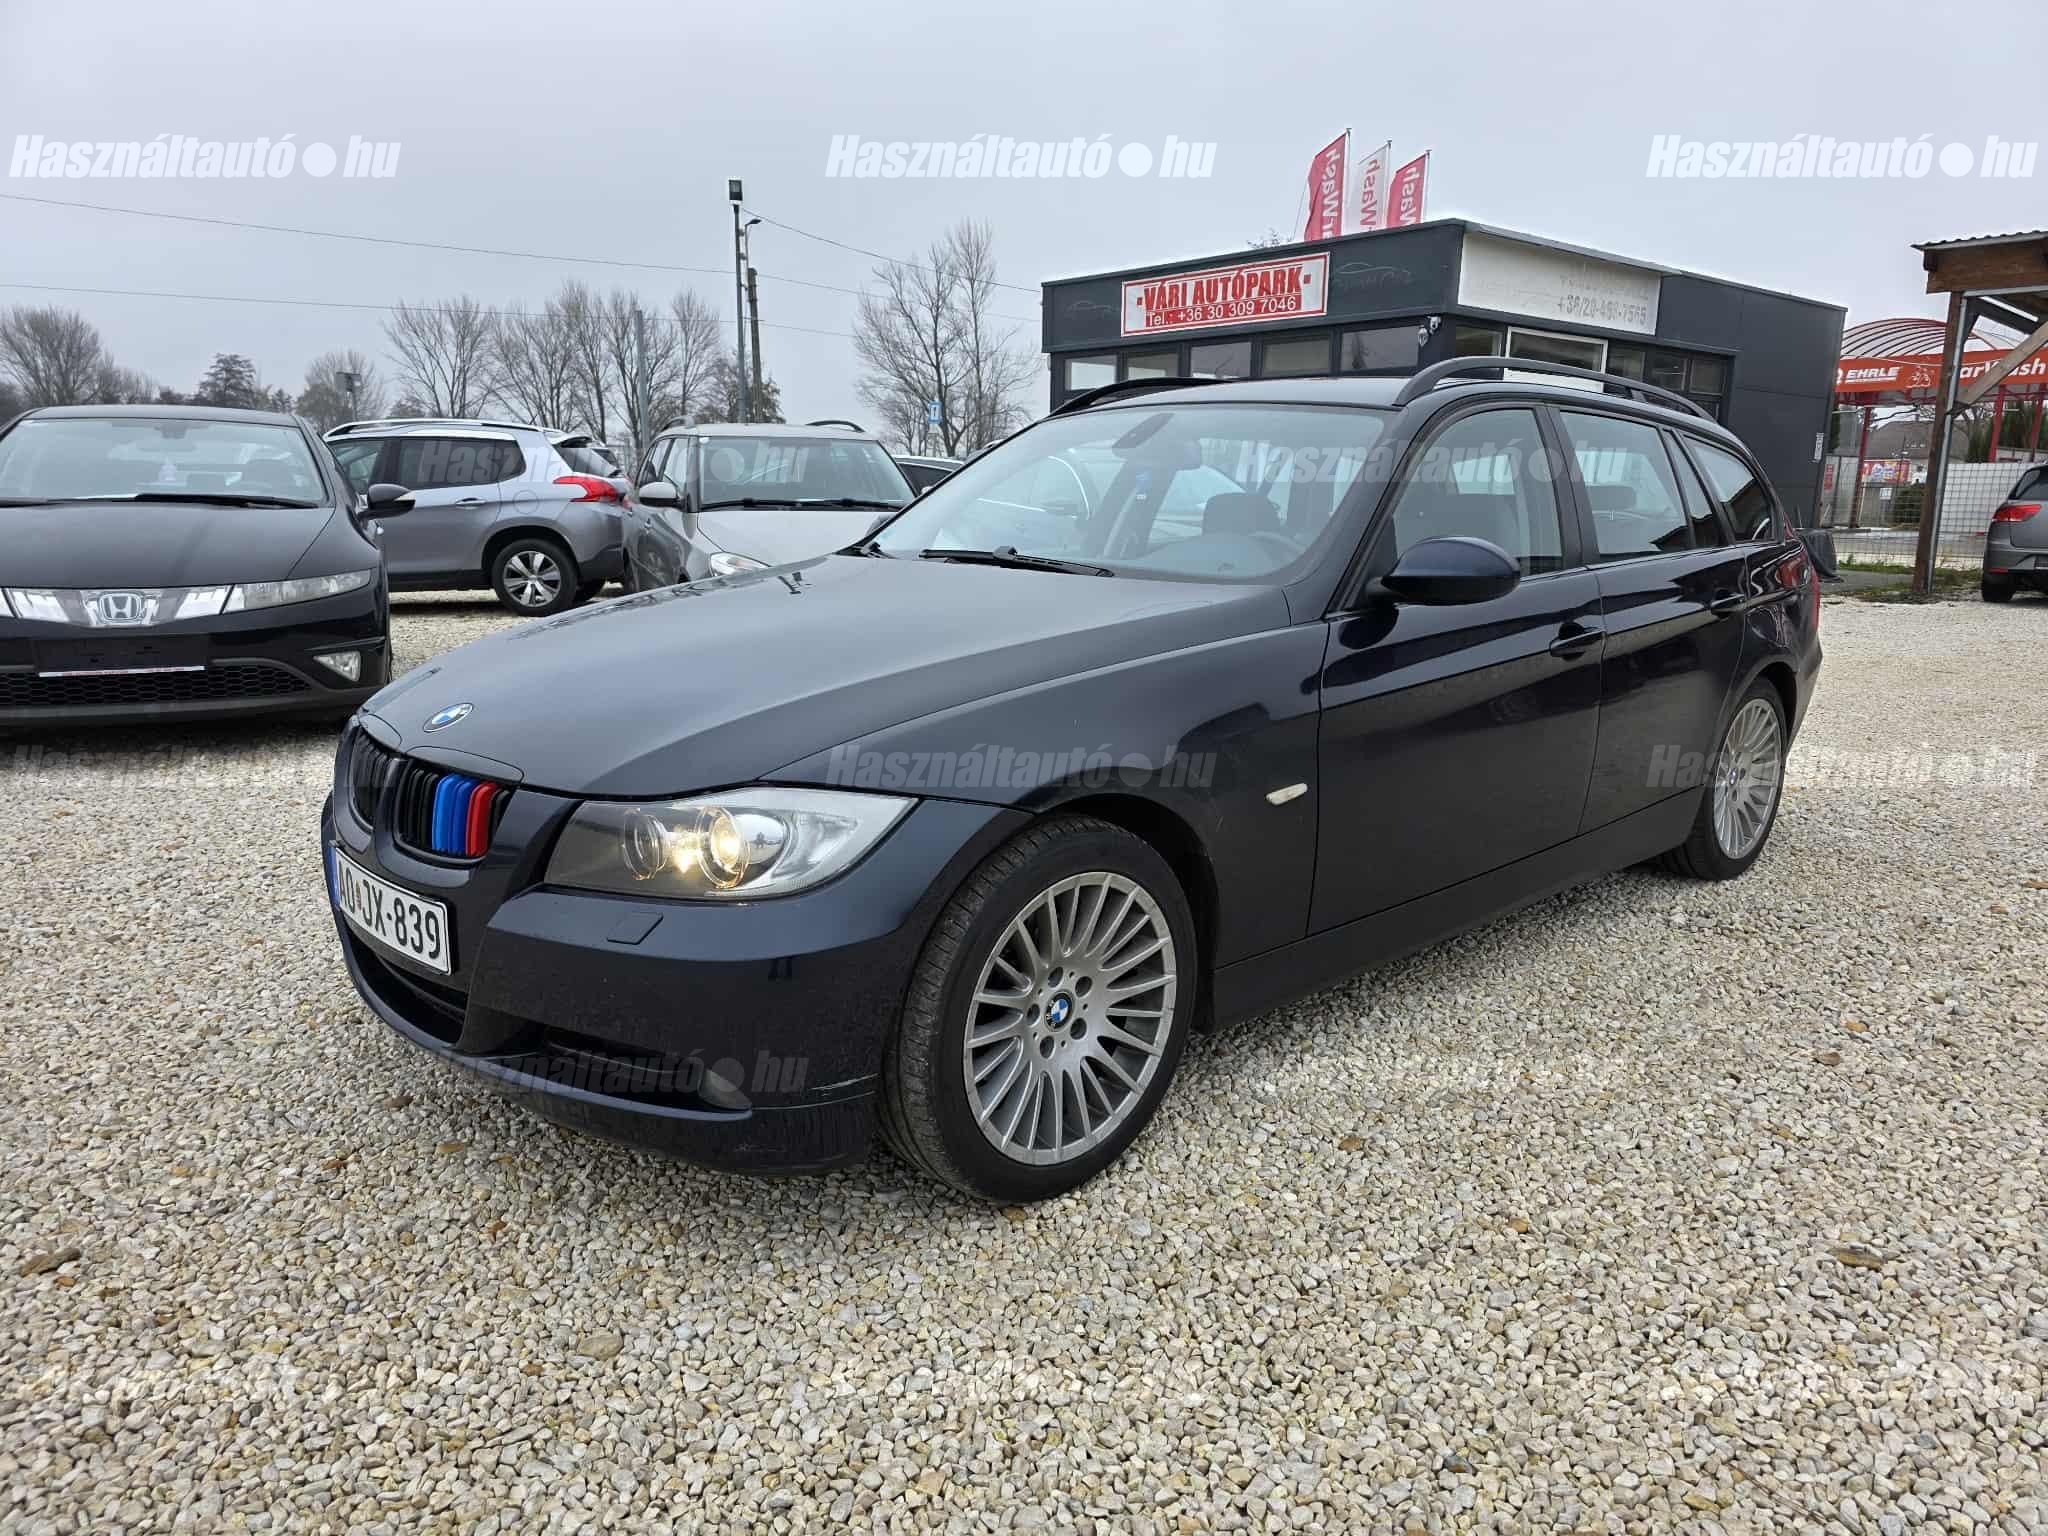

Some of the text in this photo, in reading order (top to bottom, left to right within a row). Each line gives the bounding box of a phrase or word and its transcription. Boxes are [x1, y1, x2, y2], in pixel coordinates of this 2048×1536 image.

[1192, 266, 1303, 306] AUTÓPARK
[1177, 307, 1203, 323] +36
[1207, 304, 1224, 320] 30
[1229, 300, 1255, 317] 309
[1260, 296, 1297, 314] 7046
[362, 879, 442, 959] JX-839
